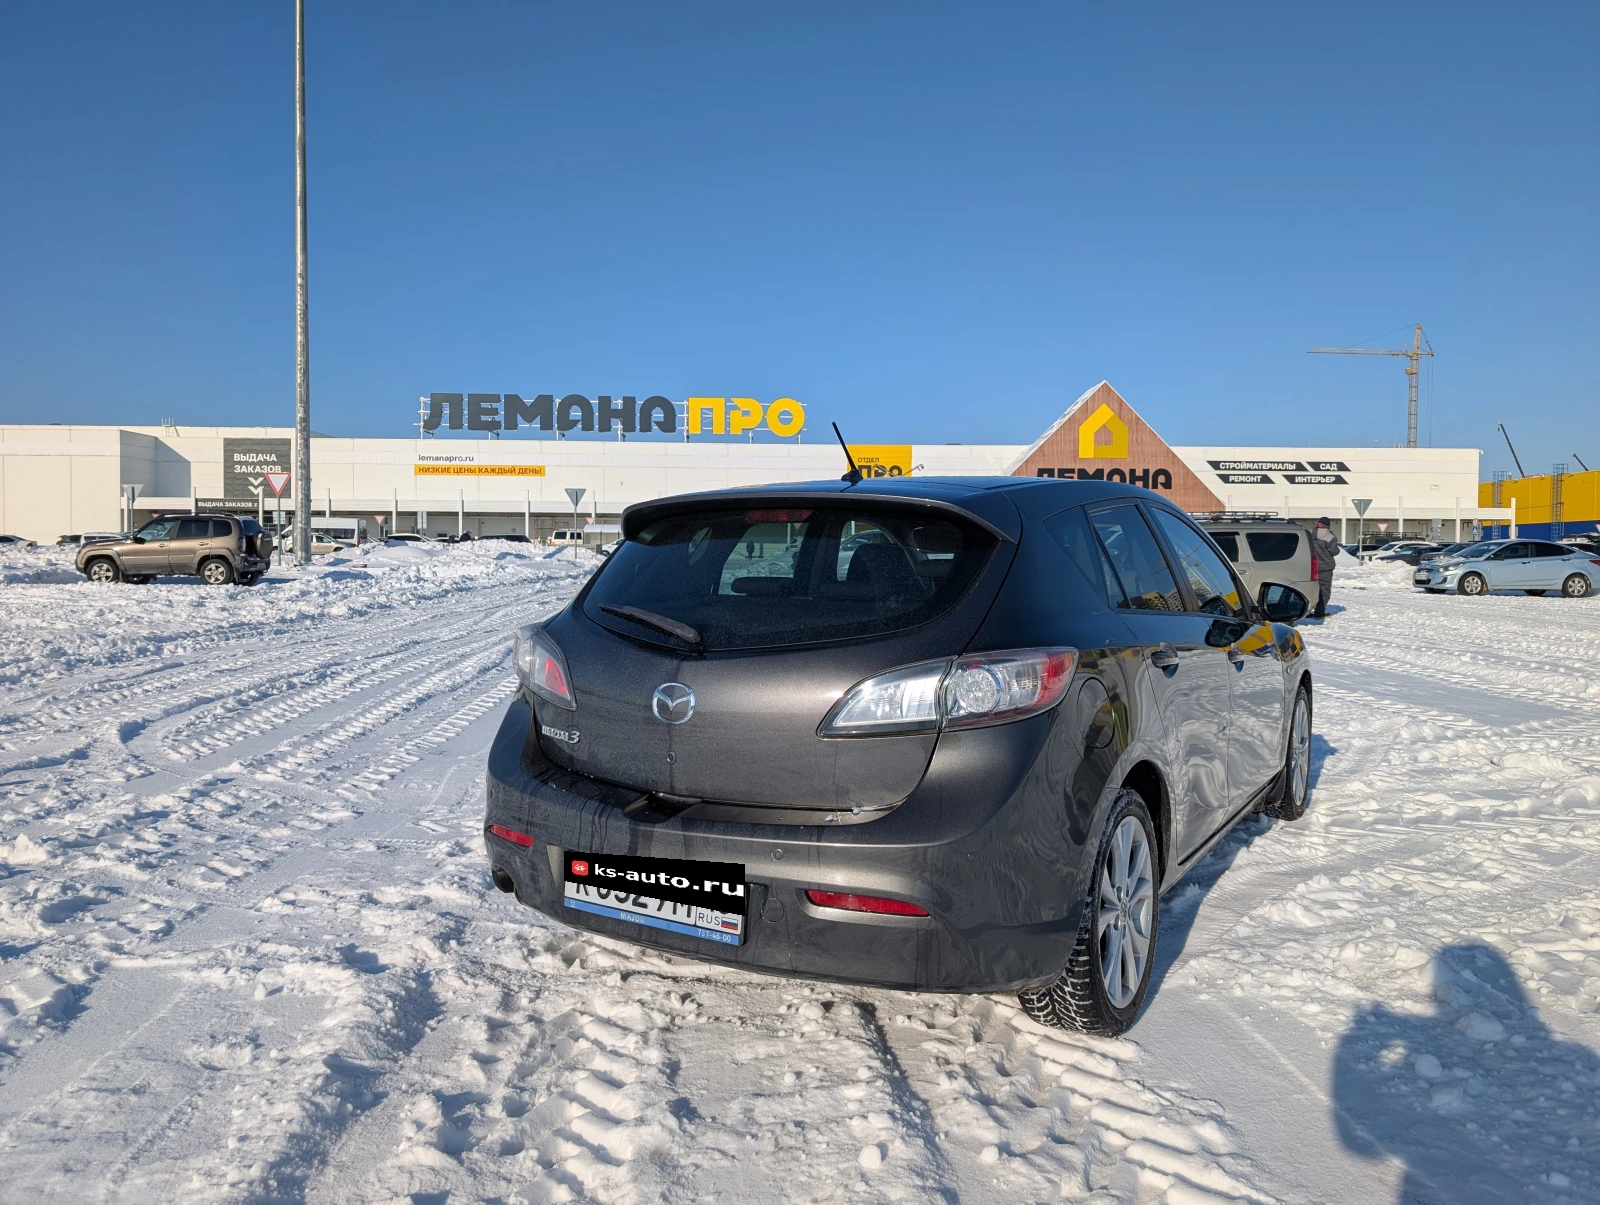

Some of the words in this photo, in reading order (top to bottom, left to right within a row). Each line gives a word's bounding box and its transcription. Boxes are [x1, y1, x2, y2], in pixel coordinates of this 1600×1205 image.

[423, 392, 677, 434] ЛЕМАНА
[687, 396, 806, 438] ПРО
[233, 453, 277, 462] ВЫДАЧА
[418, 454, 474, 463] lemanapro.ru
[233, 464, 282, 473] ЗАКАЗОВ
[418, 466, 451, 474] НИЗКИЕ
[453, 467, 477, 475] ЦЕНЫ
[478, 466, 516, 475] КАЖДЫЙ
[517, 467, 542, 475] ДЕНЬ!
[1219, 461, 1296, 471] СТРОЙМАТЕРИАЛЫ
[1319, 463, 1338, 471] САД
[1228, 475, 1262, 483] РЕМОНТ
[698, 912, 721, 926] RUS
